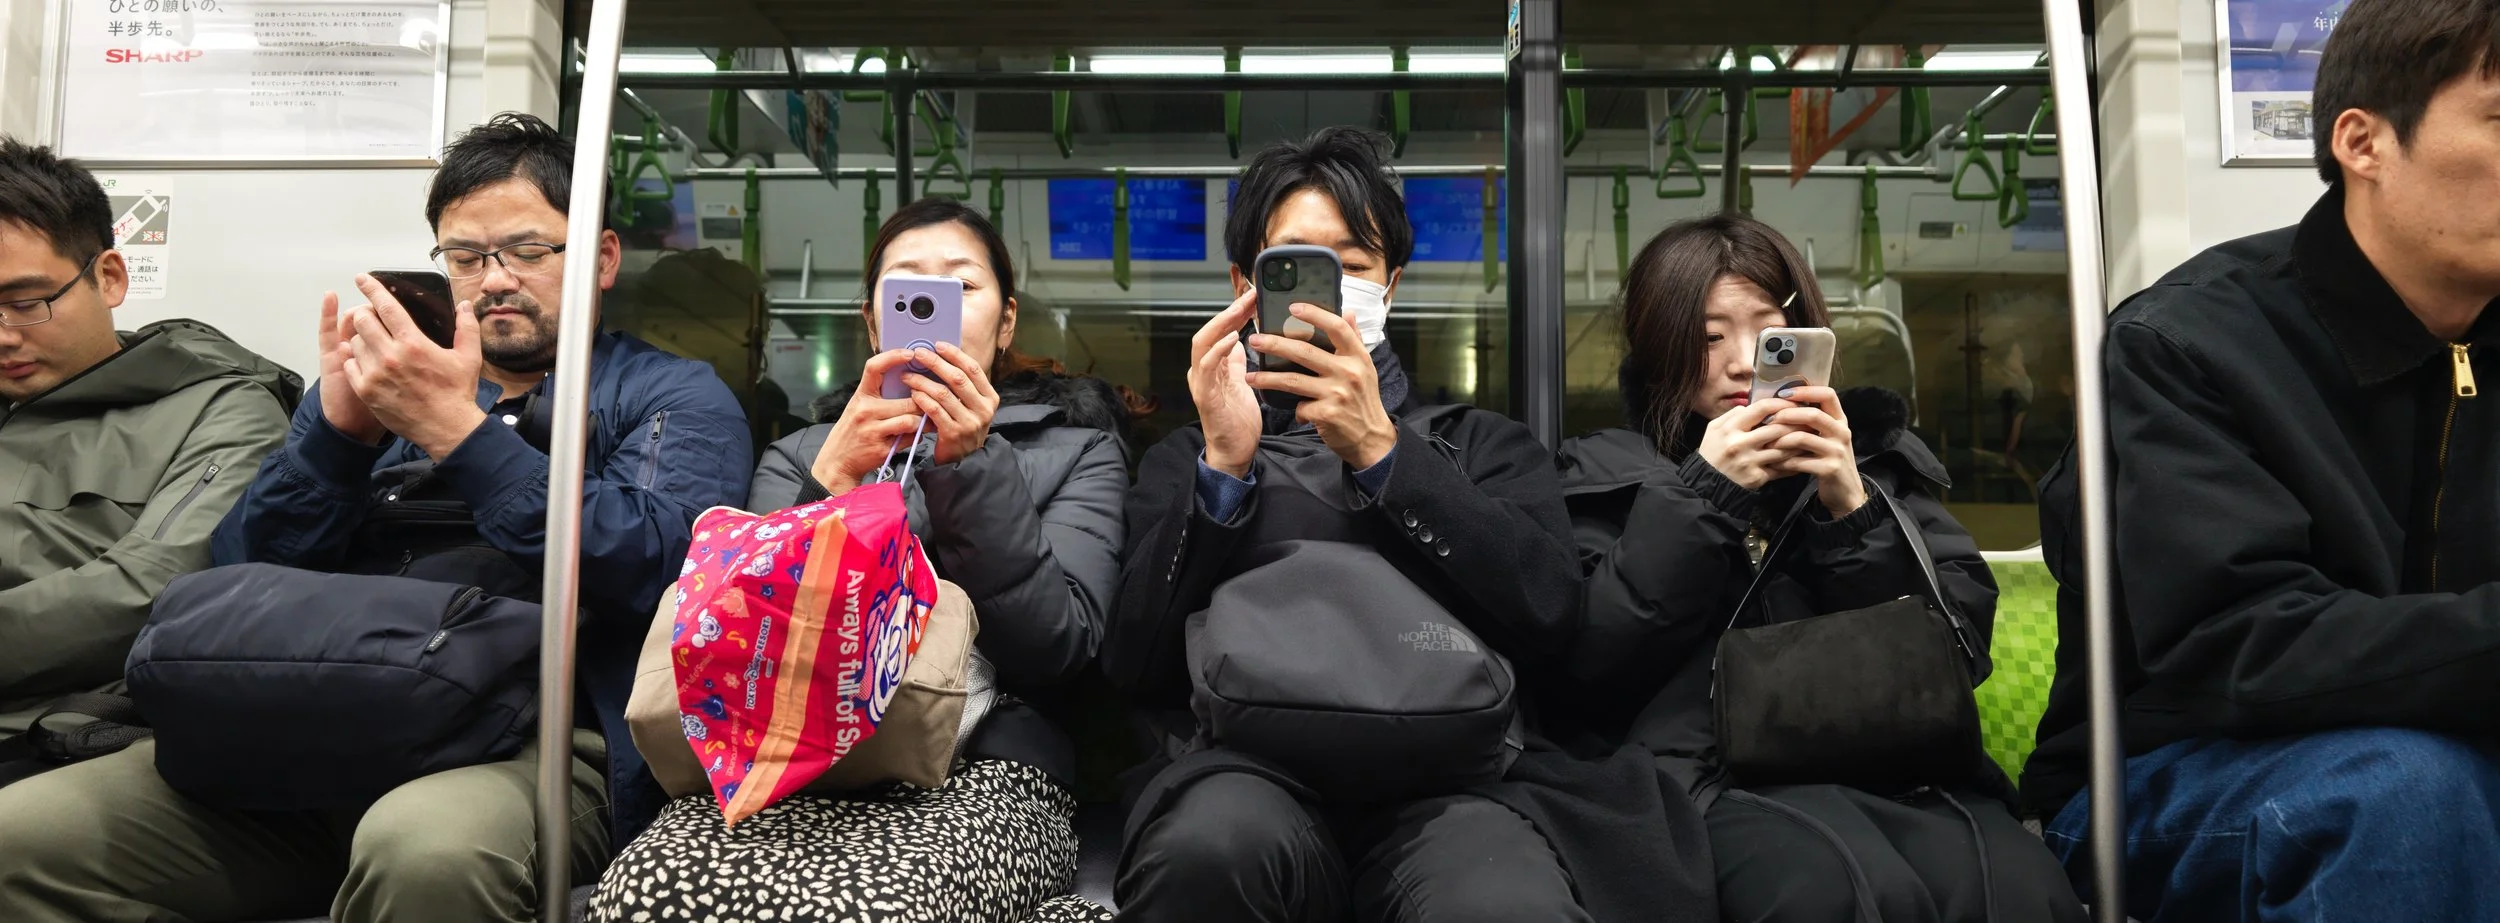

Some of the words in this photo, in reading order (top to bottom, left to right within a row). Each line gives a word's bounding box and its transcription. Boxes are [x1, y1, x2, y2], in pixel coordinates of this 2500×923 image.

[109, 0, 223, 13] ひとの願いの、
[108, 20, 173, 36] 半歩先。
[105, 49, 203, 64] SHARP
[1420, 622, 1449, 632] THE
[1398, 631, 1450, 643] NORTH
[1413, 642, 1451, 652] FACE
[745, 680, 757, 710] TOKYO
[755, 616, 772, 652] RESORT
[836, 660, 862, 696] full
[836, 700, 860, 722] of
